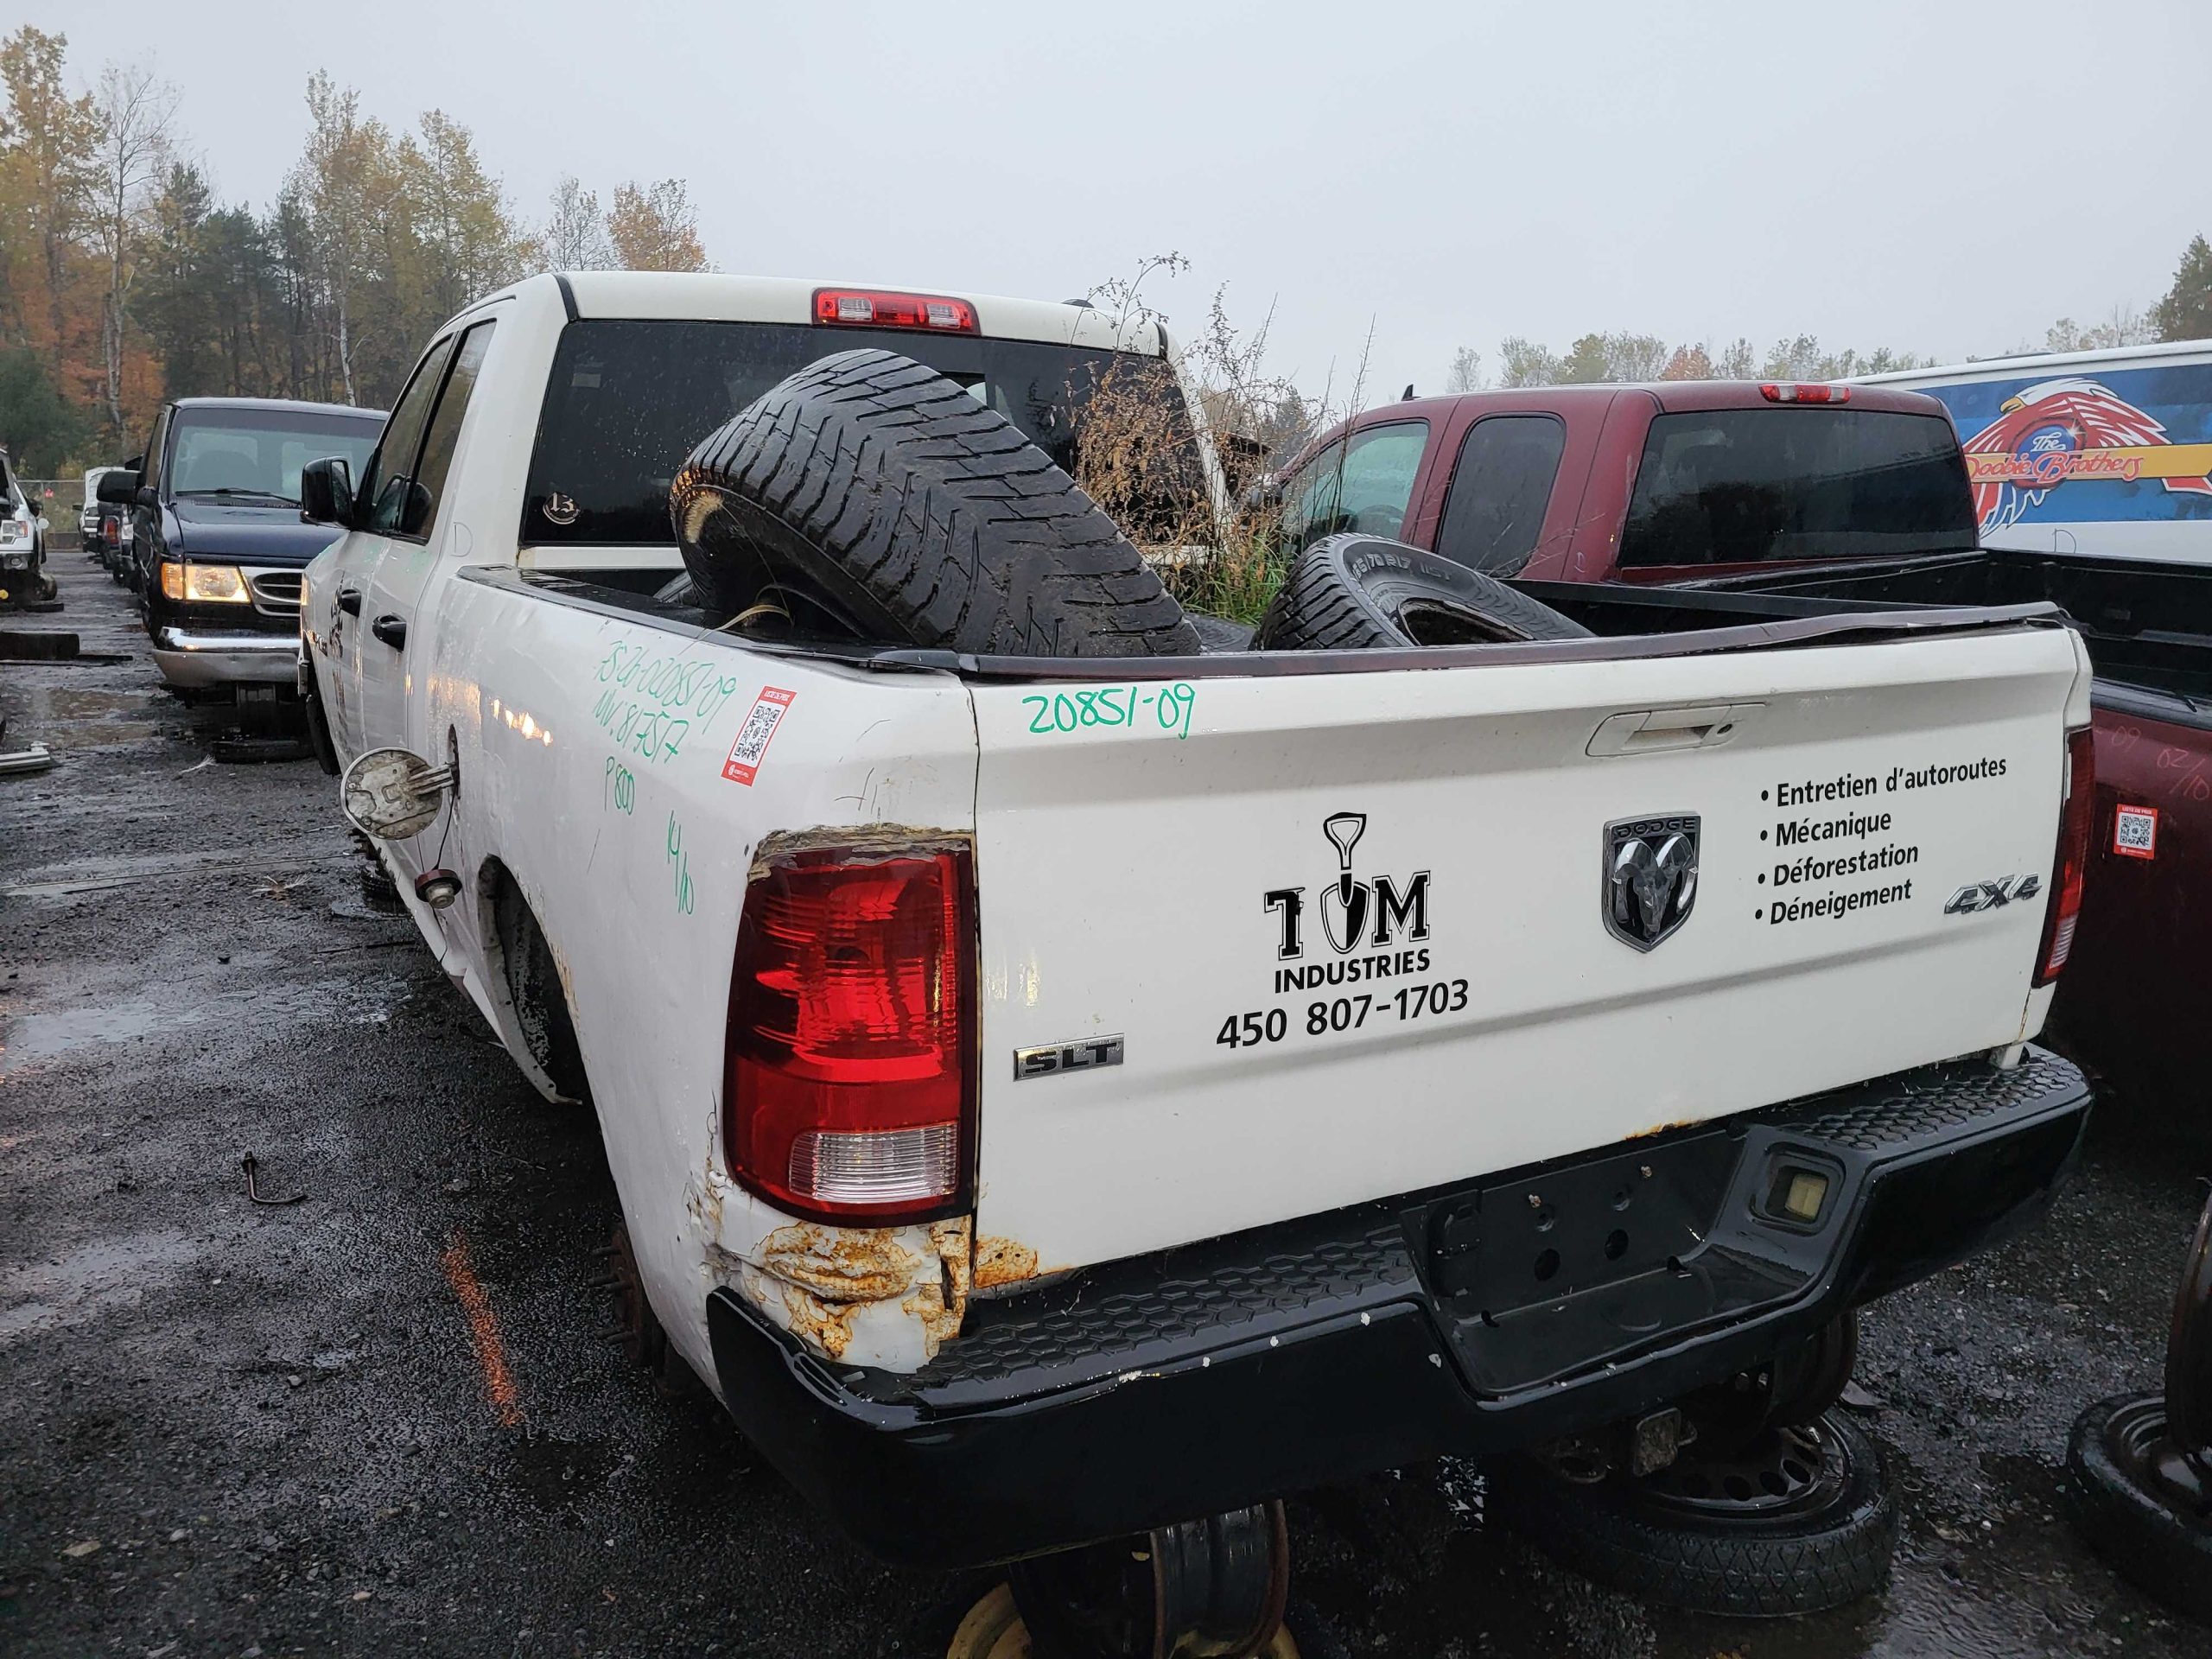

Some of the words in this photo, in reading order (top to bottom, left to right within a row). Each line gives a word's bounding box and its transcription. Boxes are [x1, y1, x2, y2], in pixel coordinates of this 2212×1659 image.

[2031, 432, 2066, 452] The
[1965, 453, 2031, 478] Doobie
[2032, 451, 2143, 482] Brothers
[1351, 553, 1384, 582] 65/70
[1022, 683, 1196, 740] 20851-09
[1777, 772, 1878, 807] Entretien
[1885, 757, 2007, 791] d'autoroutes
[1617, 817, 1695, 837] DODGE
[1776, 811, 1891, 847] Mécanique
[1773, 843, 1918, 887] Déforestation
[1770, 878, 1912, 925] Déneigement
[1274, 948, 1431, 994] INDUSTRIES
[1216, 1008, 1287, 1049] 450
[1306, 978, 1469, 1036] 807-1703
[1025, 1042, 1117, 1074] SLT
